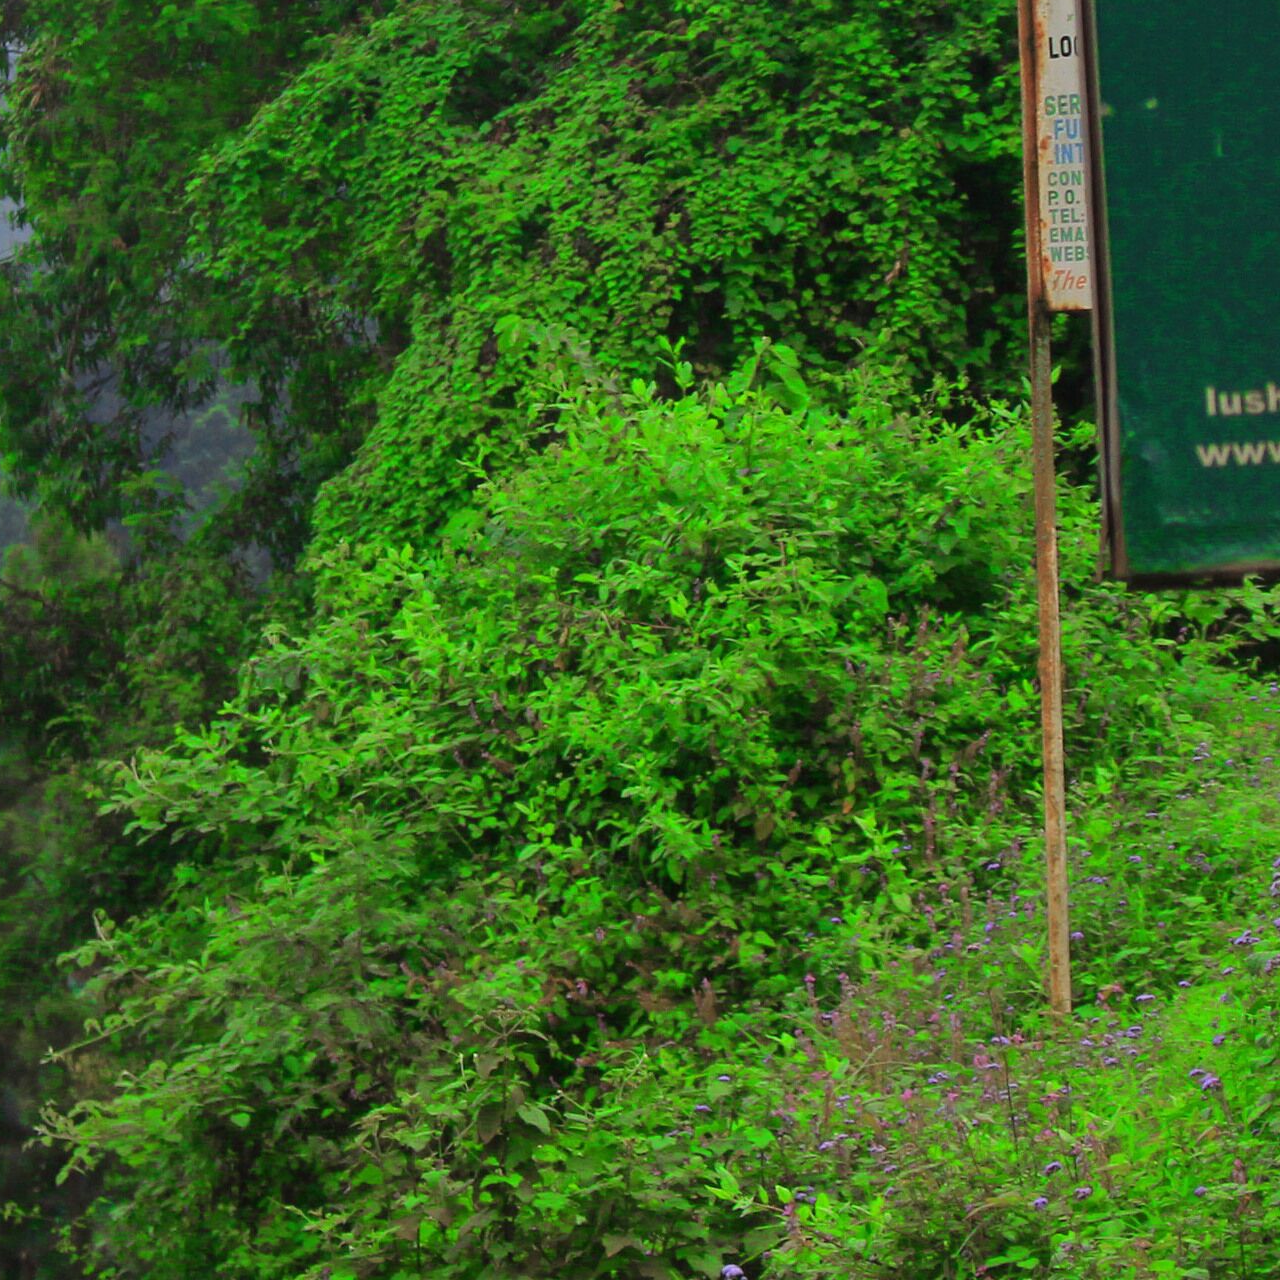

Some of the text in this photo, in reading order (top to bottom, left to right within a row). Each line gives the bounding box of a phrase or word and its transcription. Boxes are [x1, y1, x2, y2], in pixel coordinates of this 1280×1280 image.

[1048, 35, 1079, 59] LO
[1054, 118, 1080, 139] FU
[1048, 170, 1084, 187] CON
[1049, 227, 1088, 243] EMA
[1048, 246, 1088, 262] WEB
[1053, 270, 1087, 290] The
